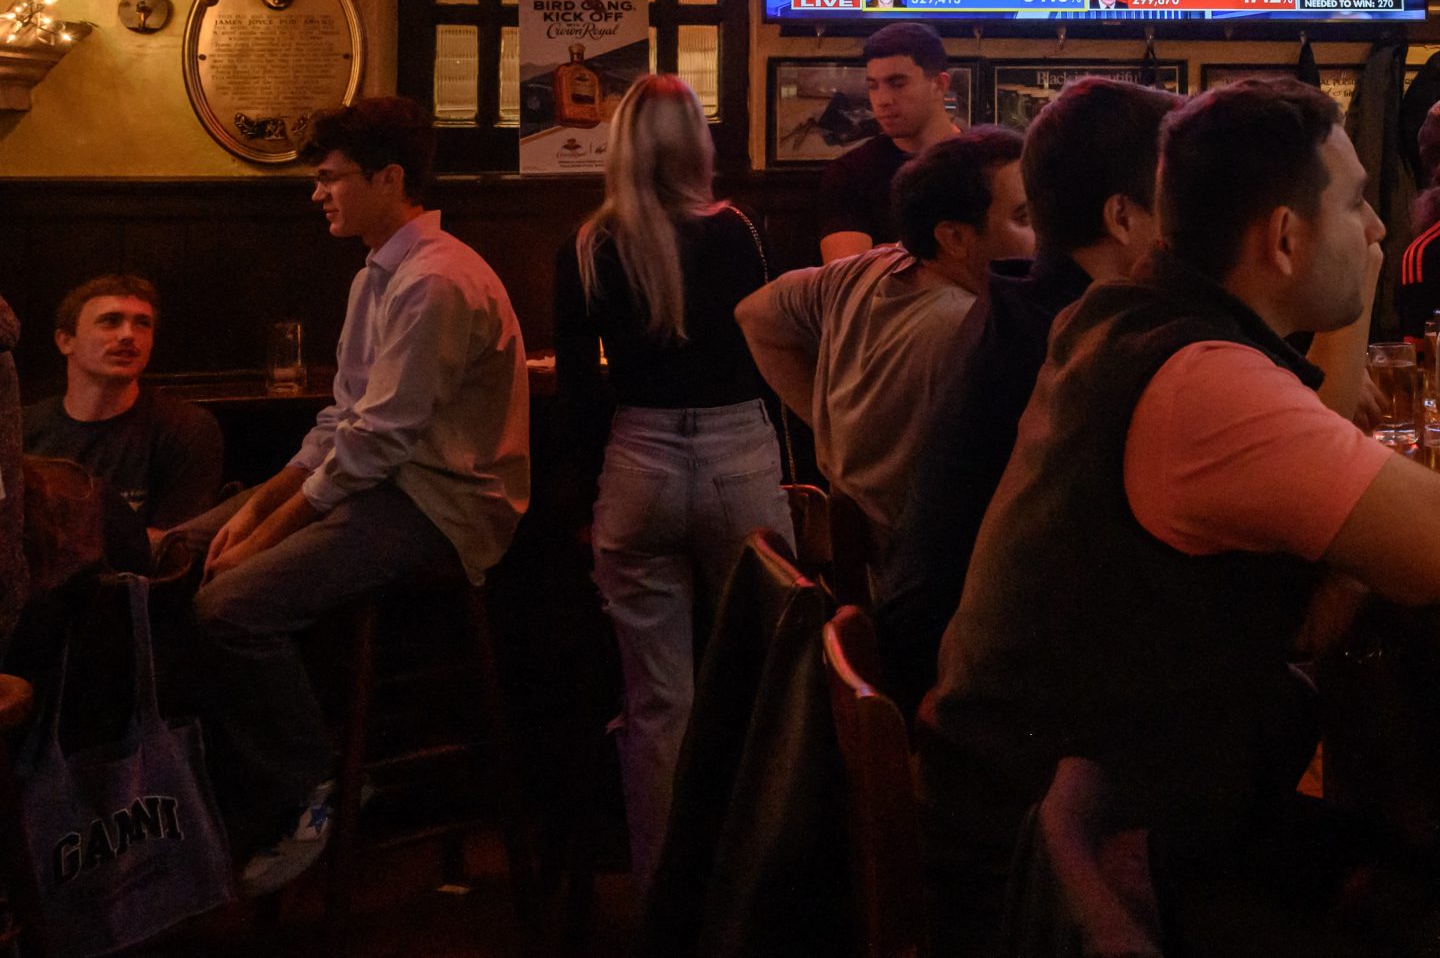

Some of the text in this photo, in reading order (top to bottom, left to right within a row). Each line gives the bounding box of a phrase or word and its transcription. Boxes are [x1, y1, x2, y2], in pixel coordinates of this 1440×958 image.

[533, 1, 633, 12] BIRD GANG
[1304, 0, 1394, 8] NEEDED TO WIN: 270
[544, 12, 623, 23] KICK OFF
[547, 23, 619, 40] Crown Royal
